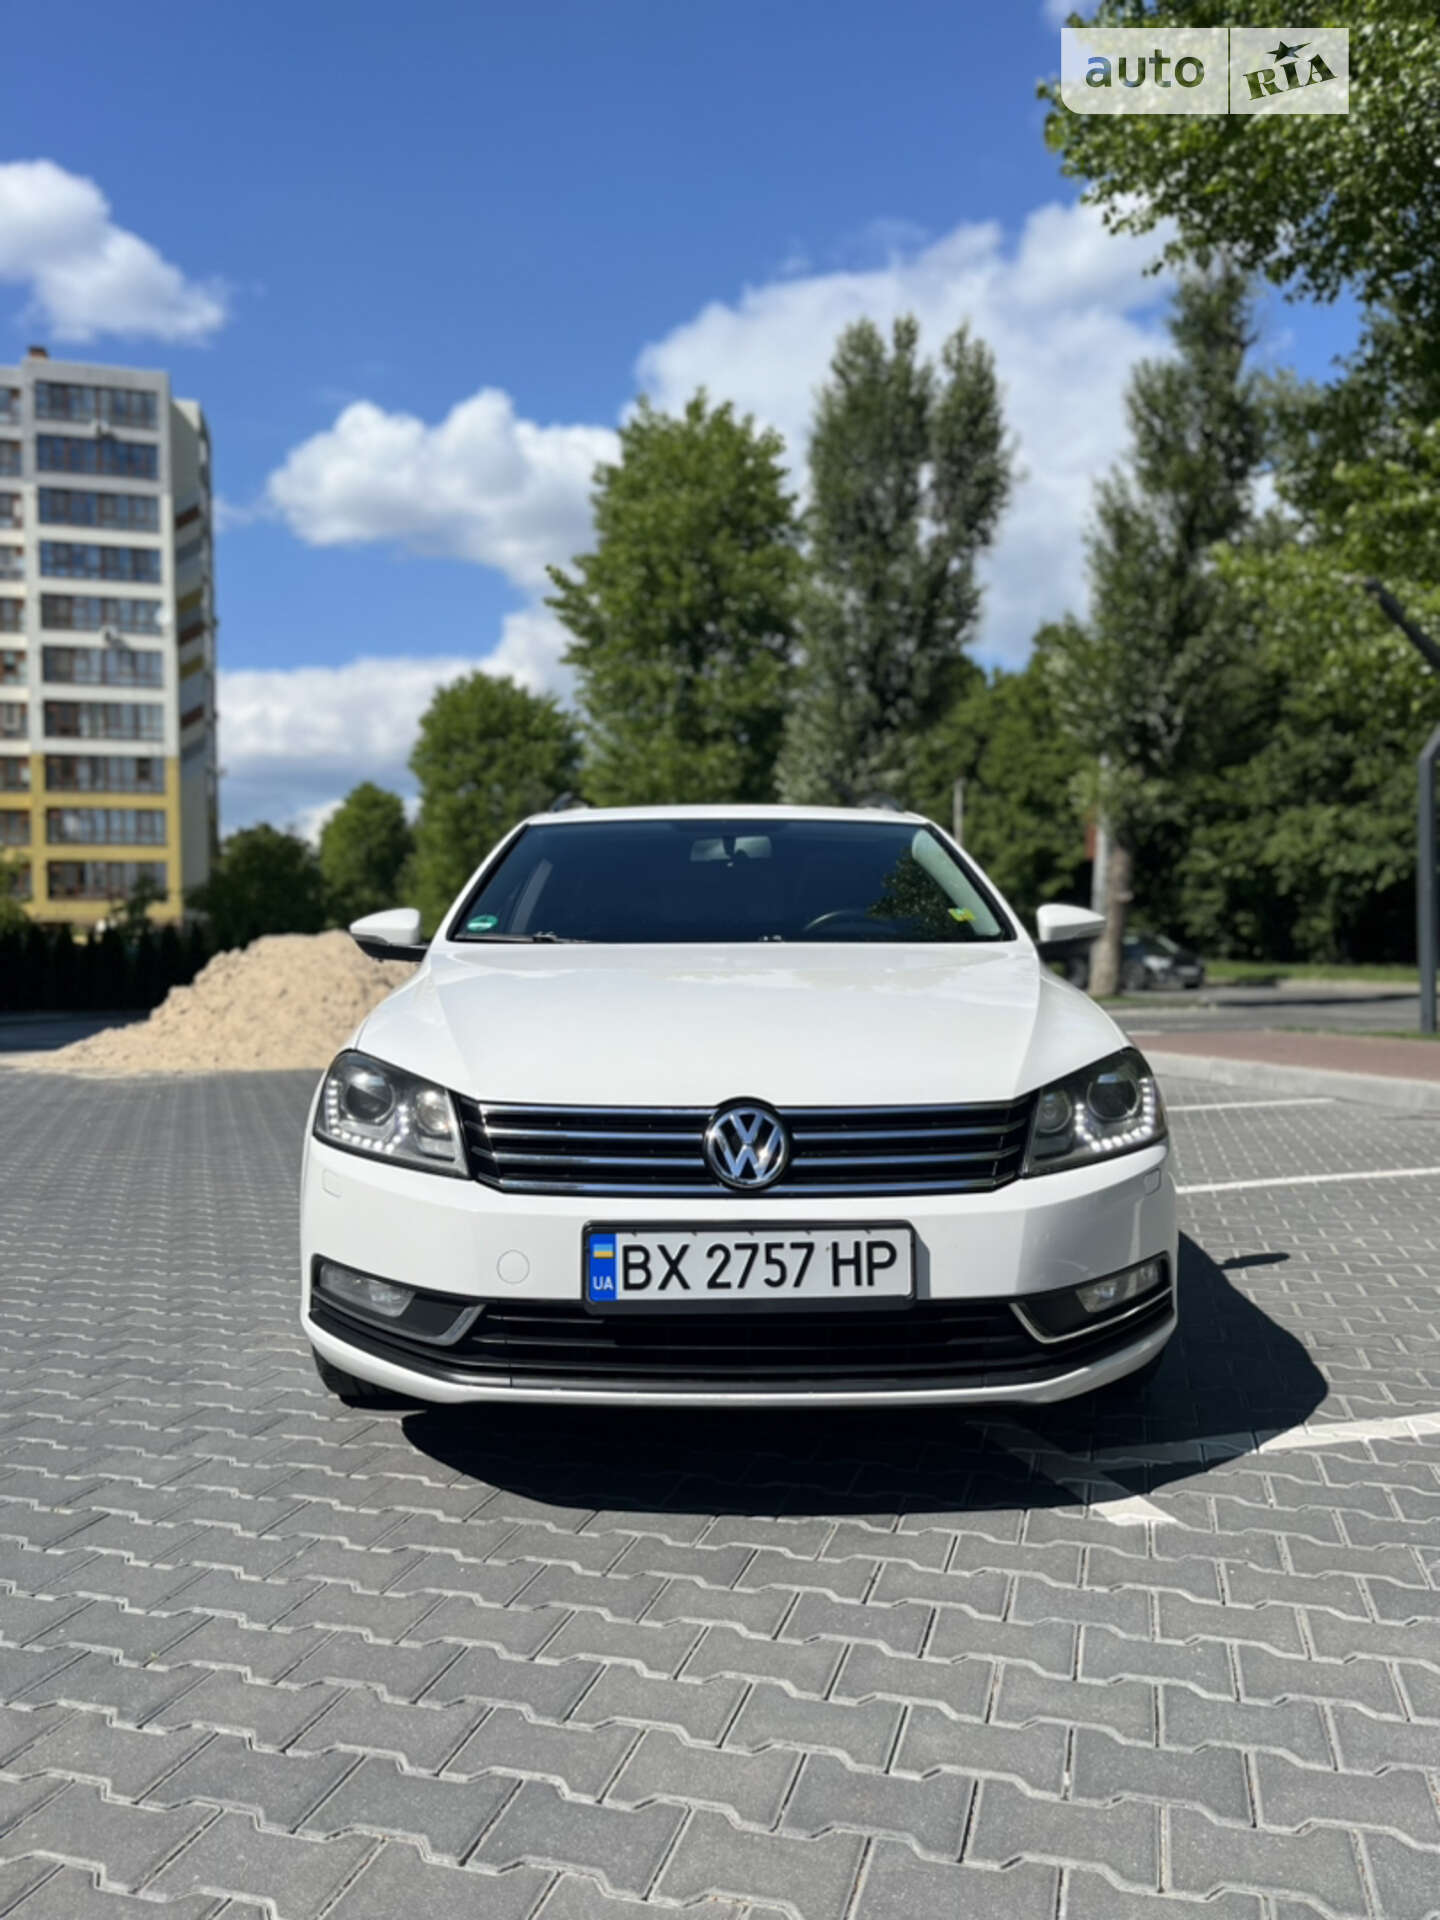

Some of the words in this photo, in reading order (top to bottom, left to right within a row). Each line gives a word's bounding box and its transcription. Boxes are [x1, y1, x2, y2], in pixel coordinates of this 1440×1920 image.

[621, 1244, 691, 1291] BX
[705, 1241, 816, 1290] 2757
[830, 1240, 898, 1288] HP
[592, 1275, 615, 1291] UA
